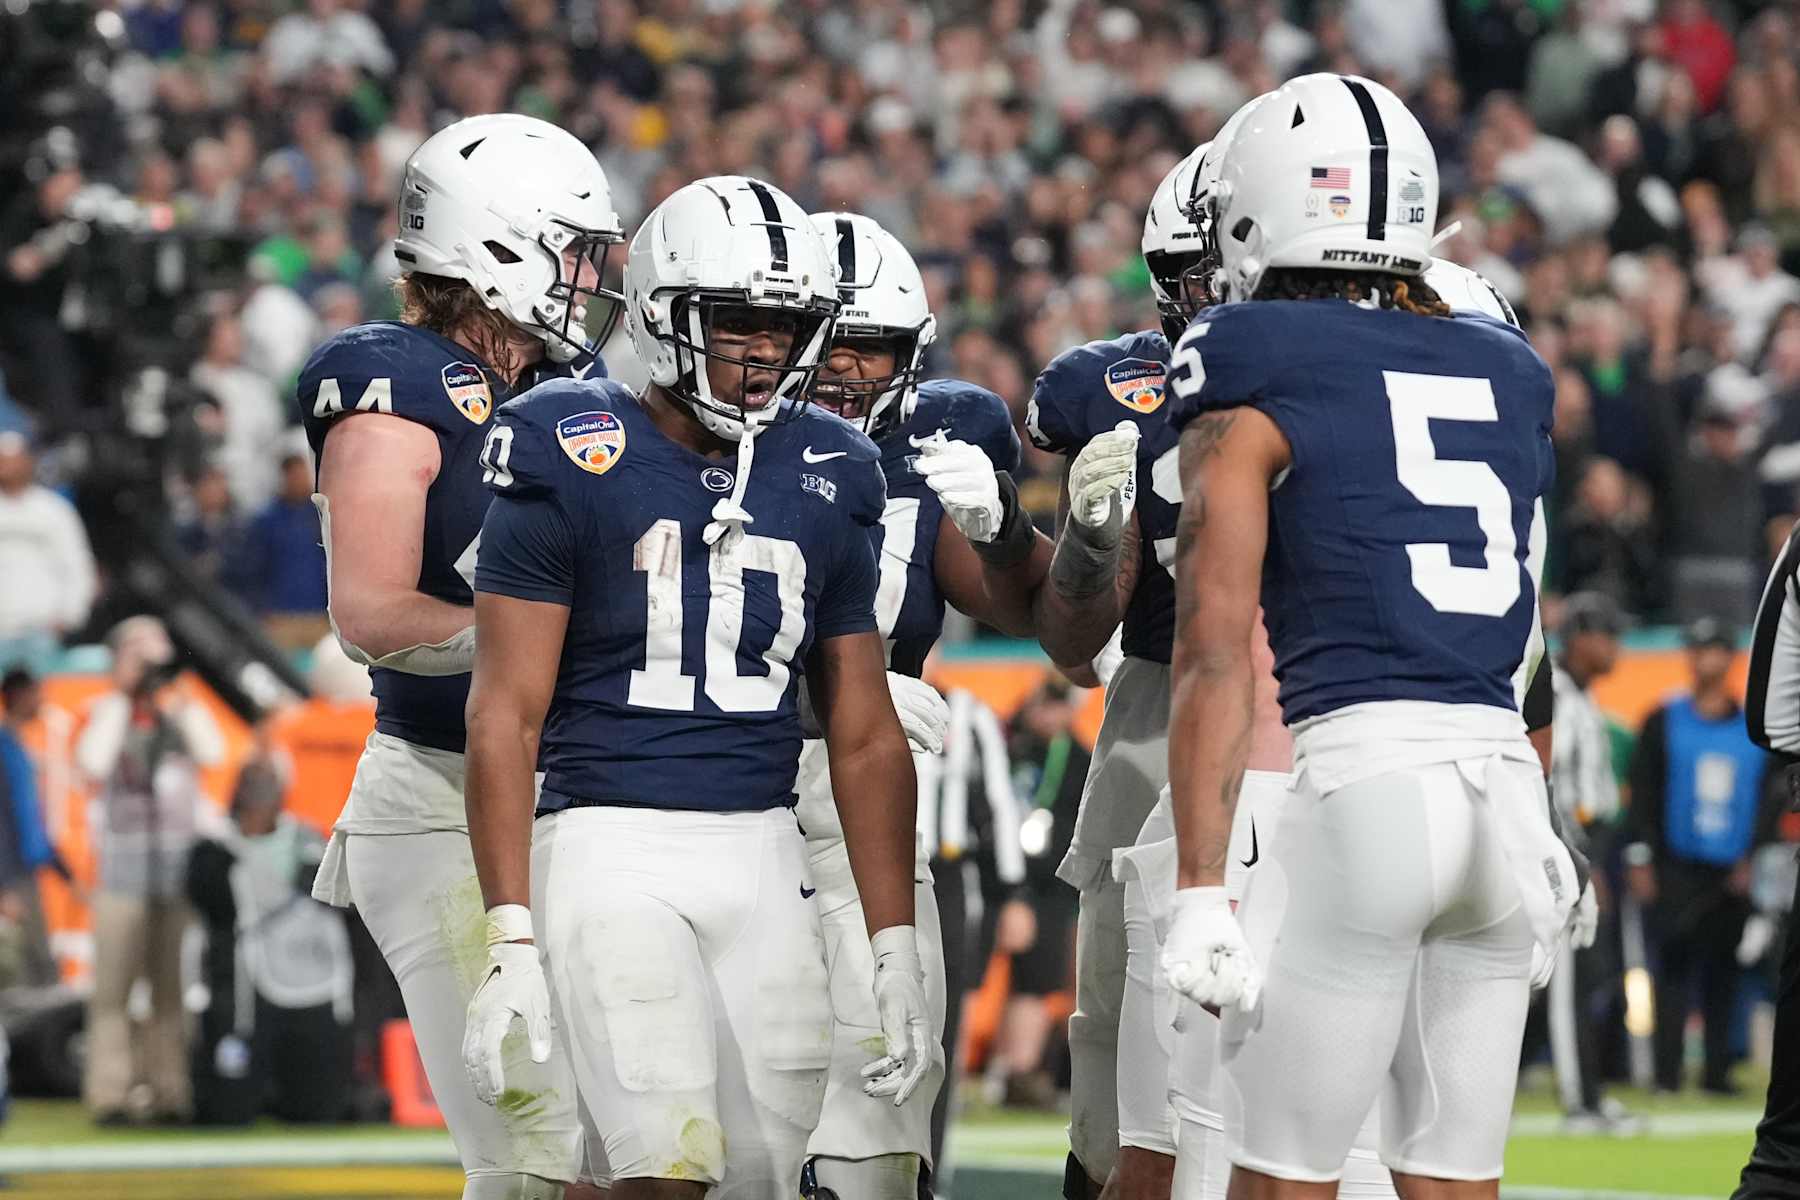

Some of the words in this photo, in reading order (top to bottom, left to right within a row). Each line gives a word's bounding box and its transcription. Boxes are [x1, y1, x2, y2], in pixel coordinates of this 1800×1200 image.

[1322, 249, 1390, 265] NITTANY
[312, 377, 394, 418] 44
[1171, 322, 1212, 399] 5
[1382, 370, 1521, 618] 5
[627, 518, 807, 713] 10
